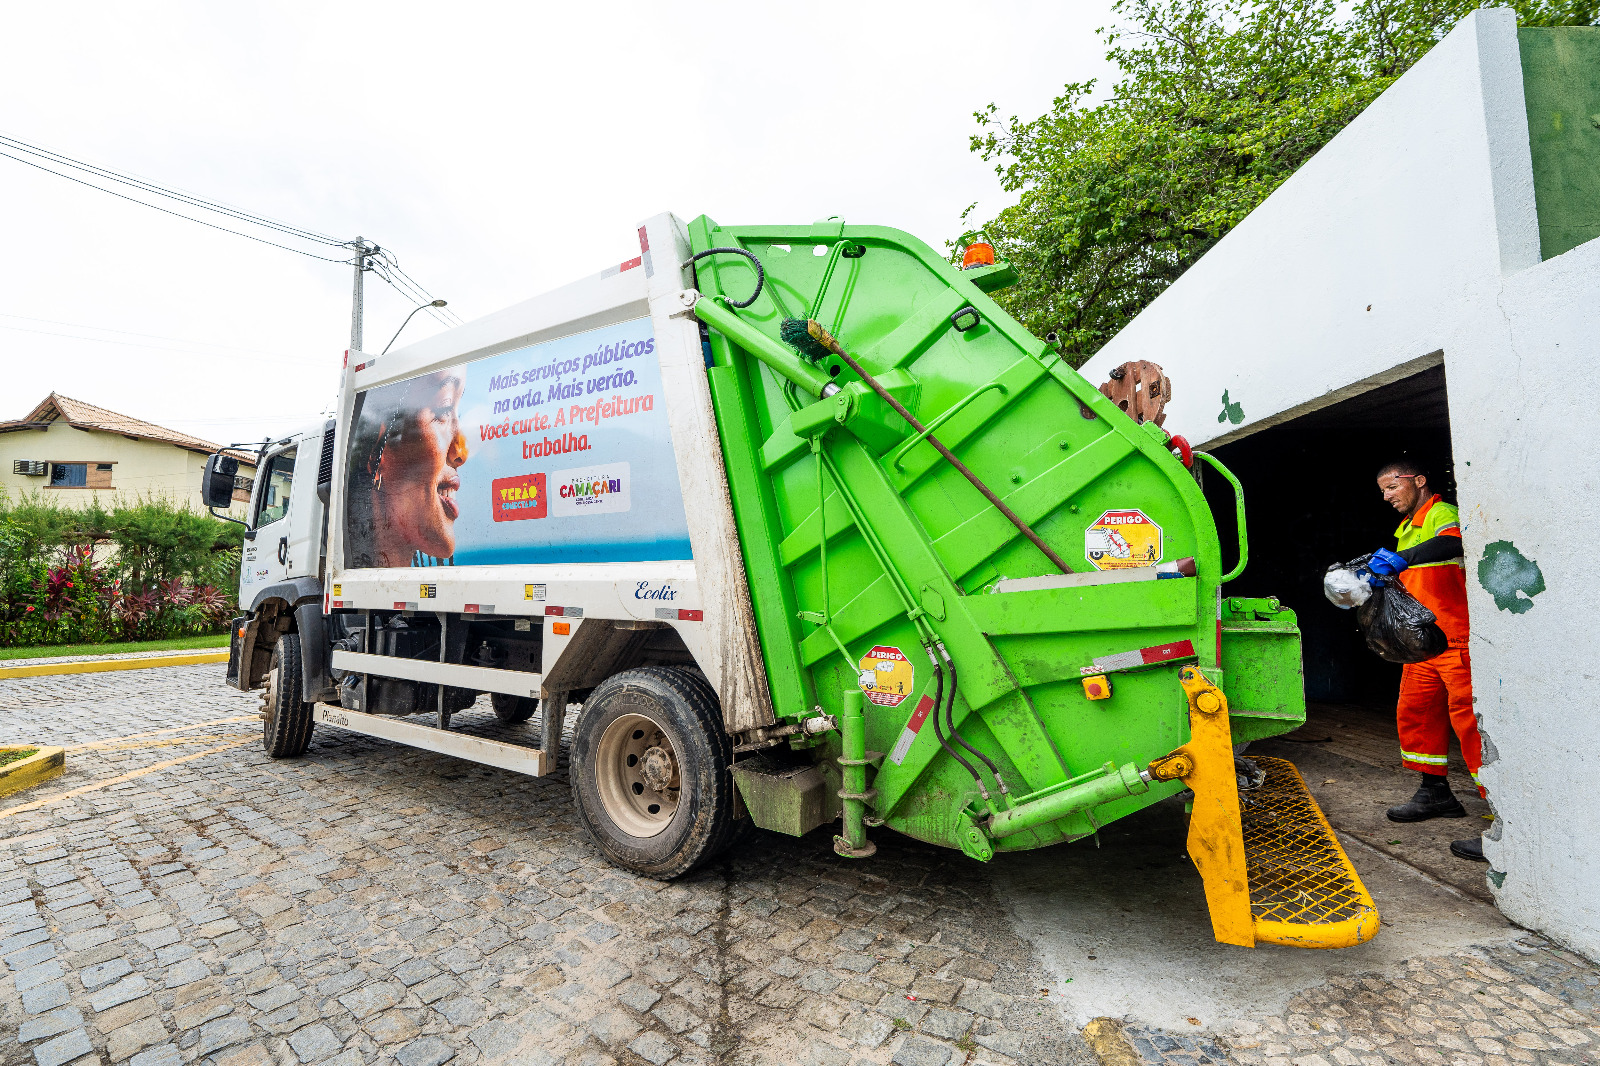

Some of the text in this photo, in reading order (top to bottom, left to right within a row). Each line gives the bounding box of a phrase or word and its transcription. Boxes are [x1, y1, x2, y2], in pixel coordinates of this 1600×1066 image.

[489, 337, 655, 392] Mais serviços públicos
[493, 367, 638, 414] na orla. Mais verão.
[479, 394, 654, 441] Você curte. A Prefeitura
[522, 432, 592, 460] trabalha.
[500, 482, 537, 501] VERÃO
[559, 478, 621, 498] CAMAÇARI
[502, 500, 537, 510] CONECTADO
[1104, 515, 1143, 525] PERIGO
[634, 580, 677, 601] Ecolix
[871, 650, 903, 661] PERIGO
